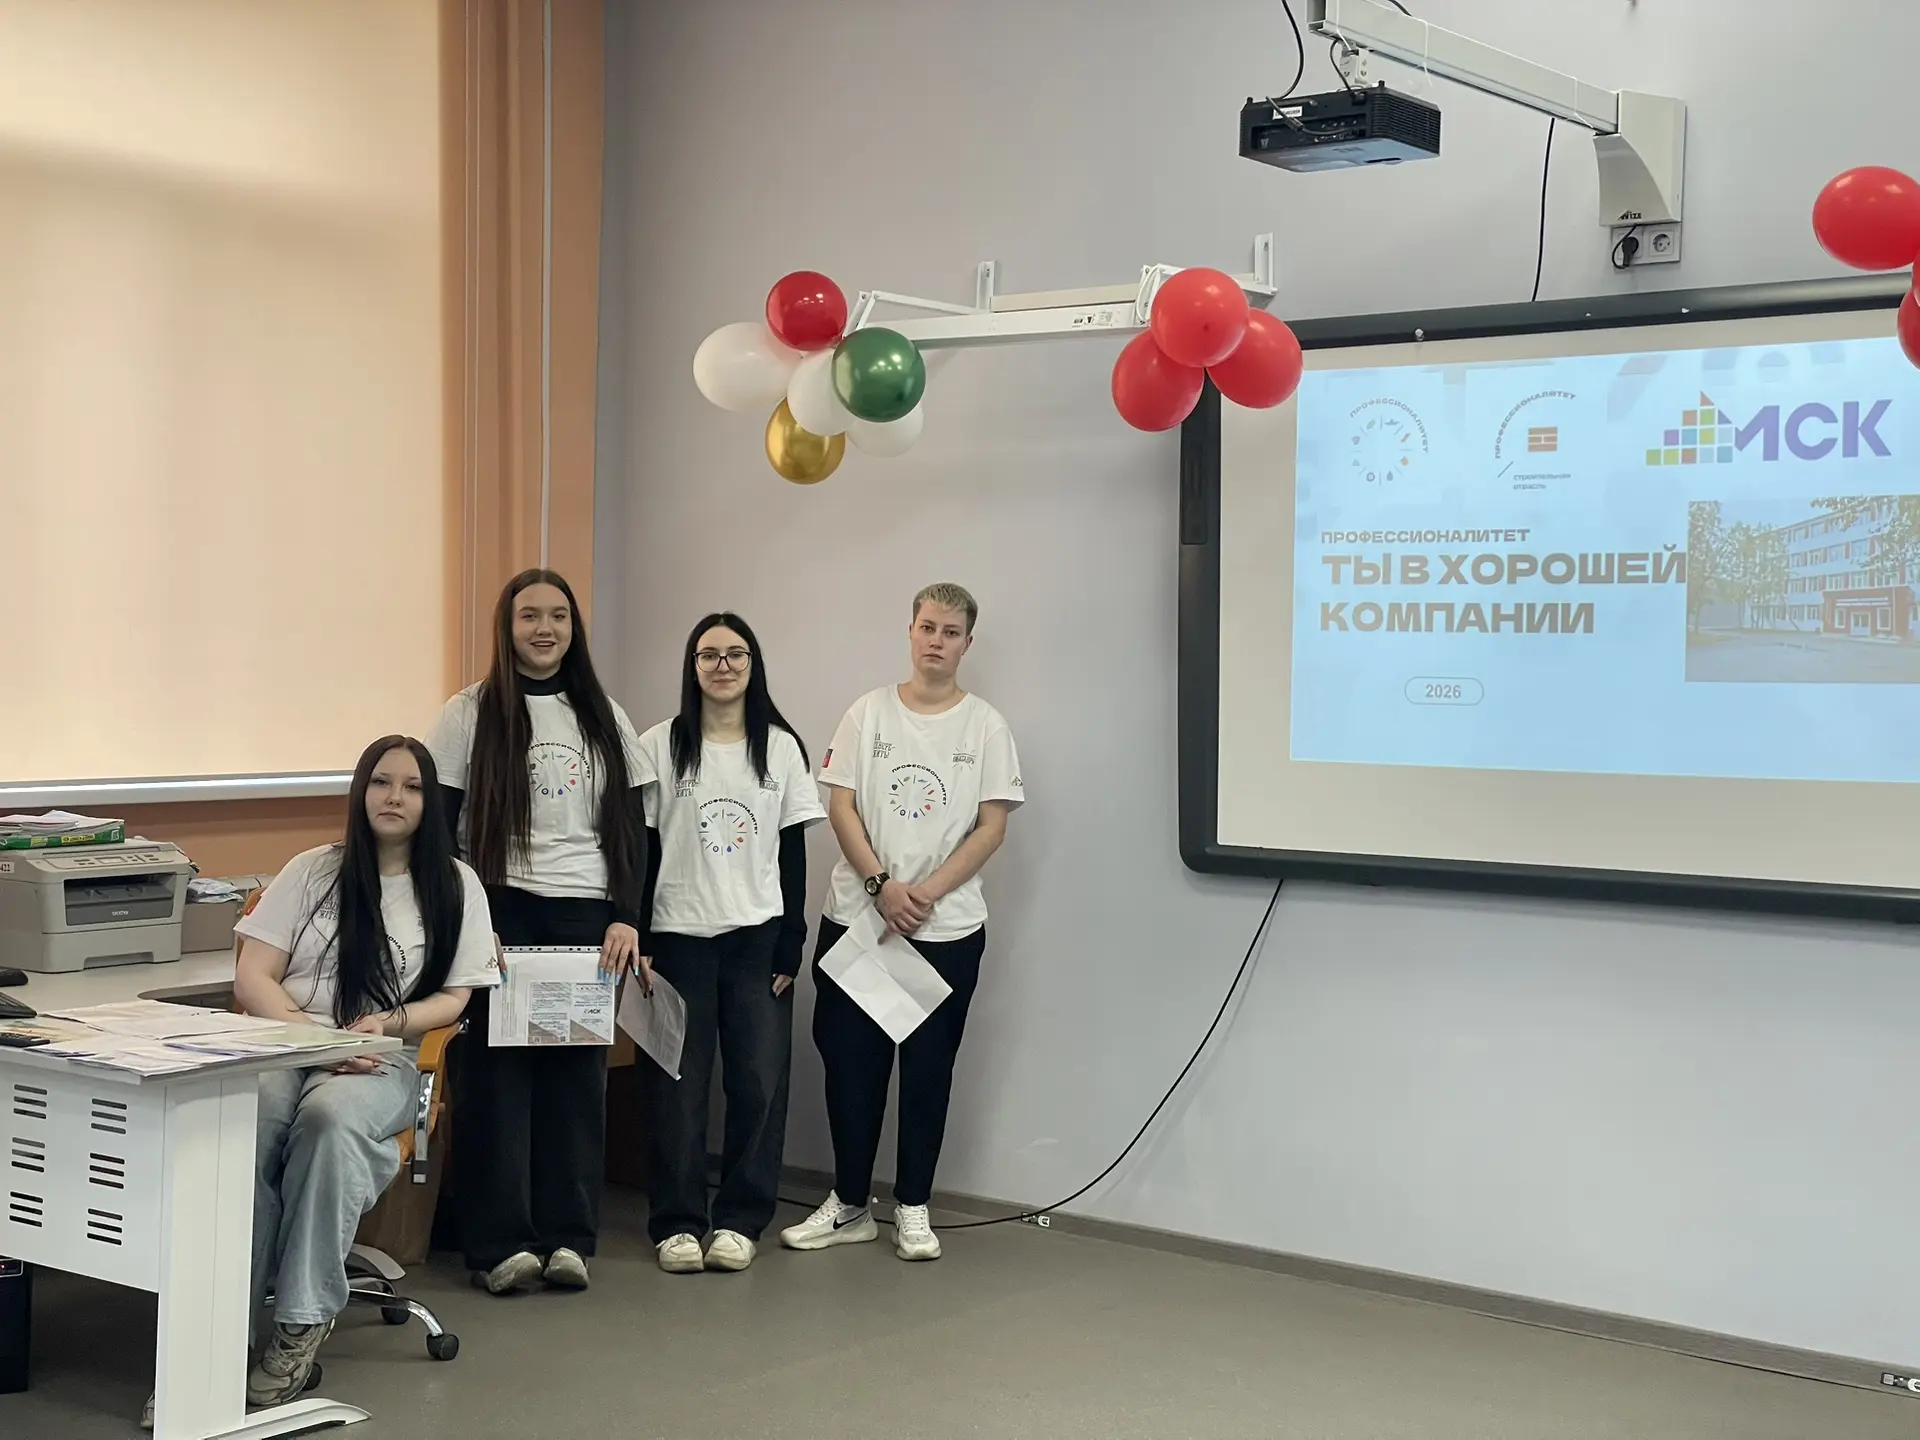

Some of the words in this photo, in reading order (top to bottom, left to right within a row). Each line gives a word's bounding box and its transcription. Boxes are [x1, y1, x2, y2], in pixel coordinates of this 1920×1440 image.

[1719, 399, 1892, 462] МСК
[1321, 529, 1531, 544] ПРОФЕССИОНАЛИТЕТ
[1322, 553, 1392, 585] ТЫ
[1400, 555, 1430, 585] В
[1437, 543, 1688, 585] ХОРОШЕЙ
[1320, 602, 1595, 634] КОМПАНИИ
[1425, 684, 1462, 698] 2026
[891, 764, 947, 806] ПРОФЕССИОНАЛИТЕТ
[699, 798, 758, 835] ПРОФЕССИОНАЛИТЕТ
